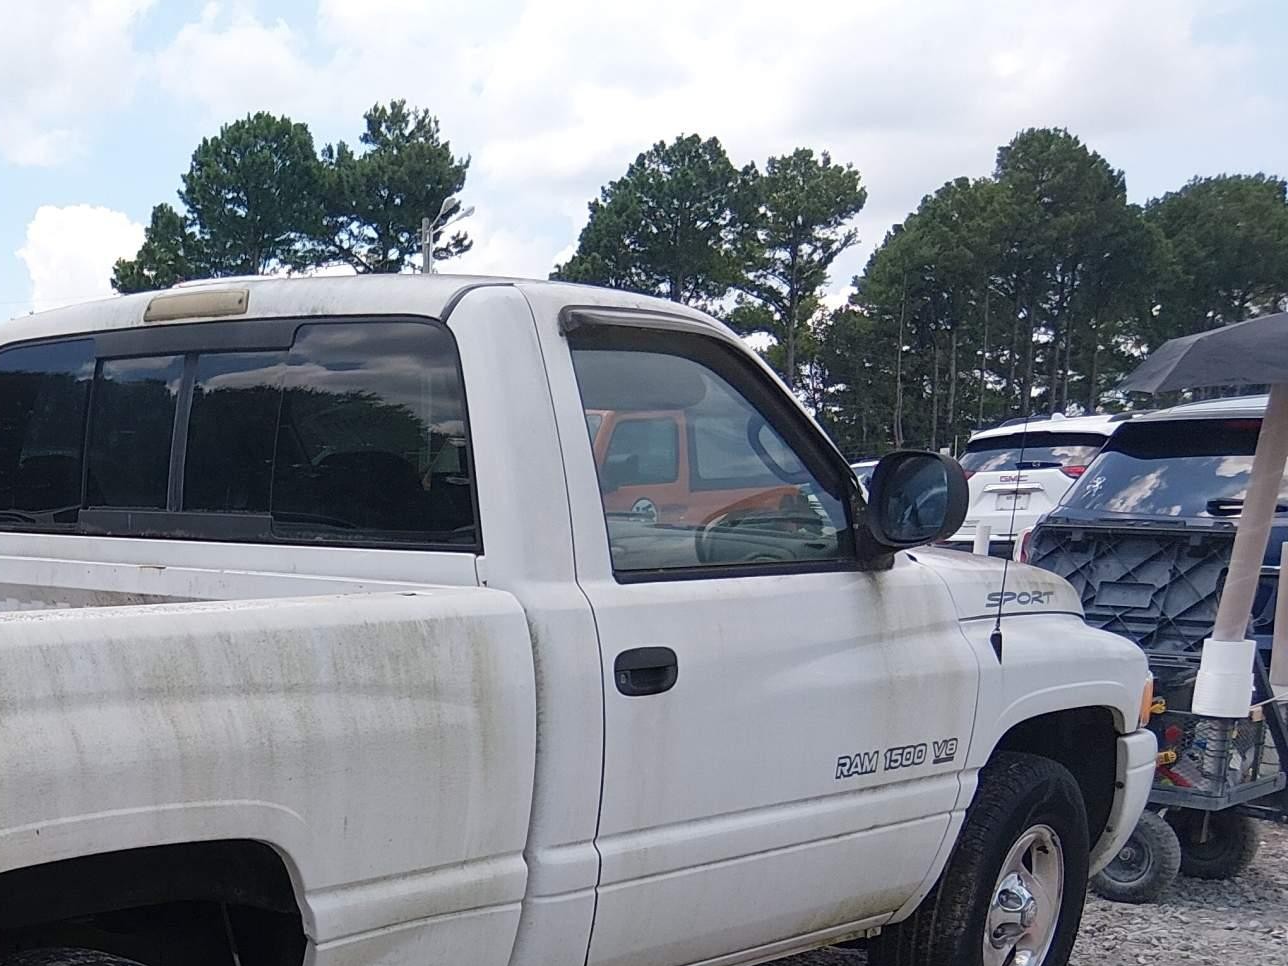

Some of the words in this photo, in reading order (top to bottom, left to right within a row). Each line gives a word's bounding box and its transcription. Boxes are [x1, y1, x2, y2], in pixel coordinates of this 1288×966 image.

[1000, 475, 1028, 483] GMC
[985, 591, 1053, 608] SPORT
[835, 751, 879, 779] RAM
[884, 744, 927, 770] 1500
[932, 737, 958, 759] V8
